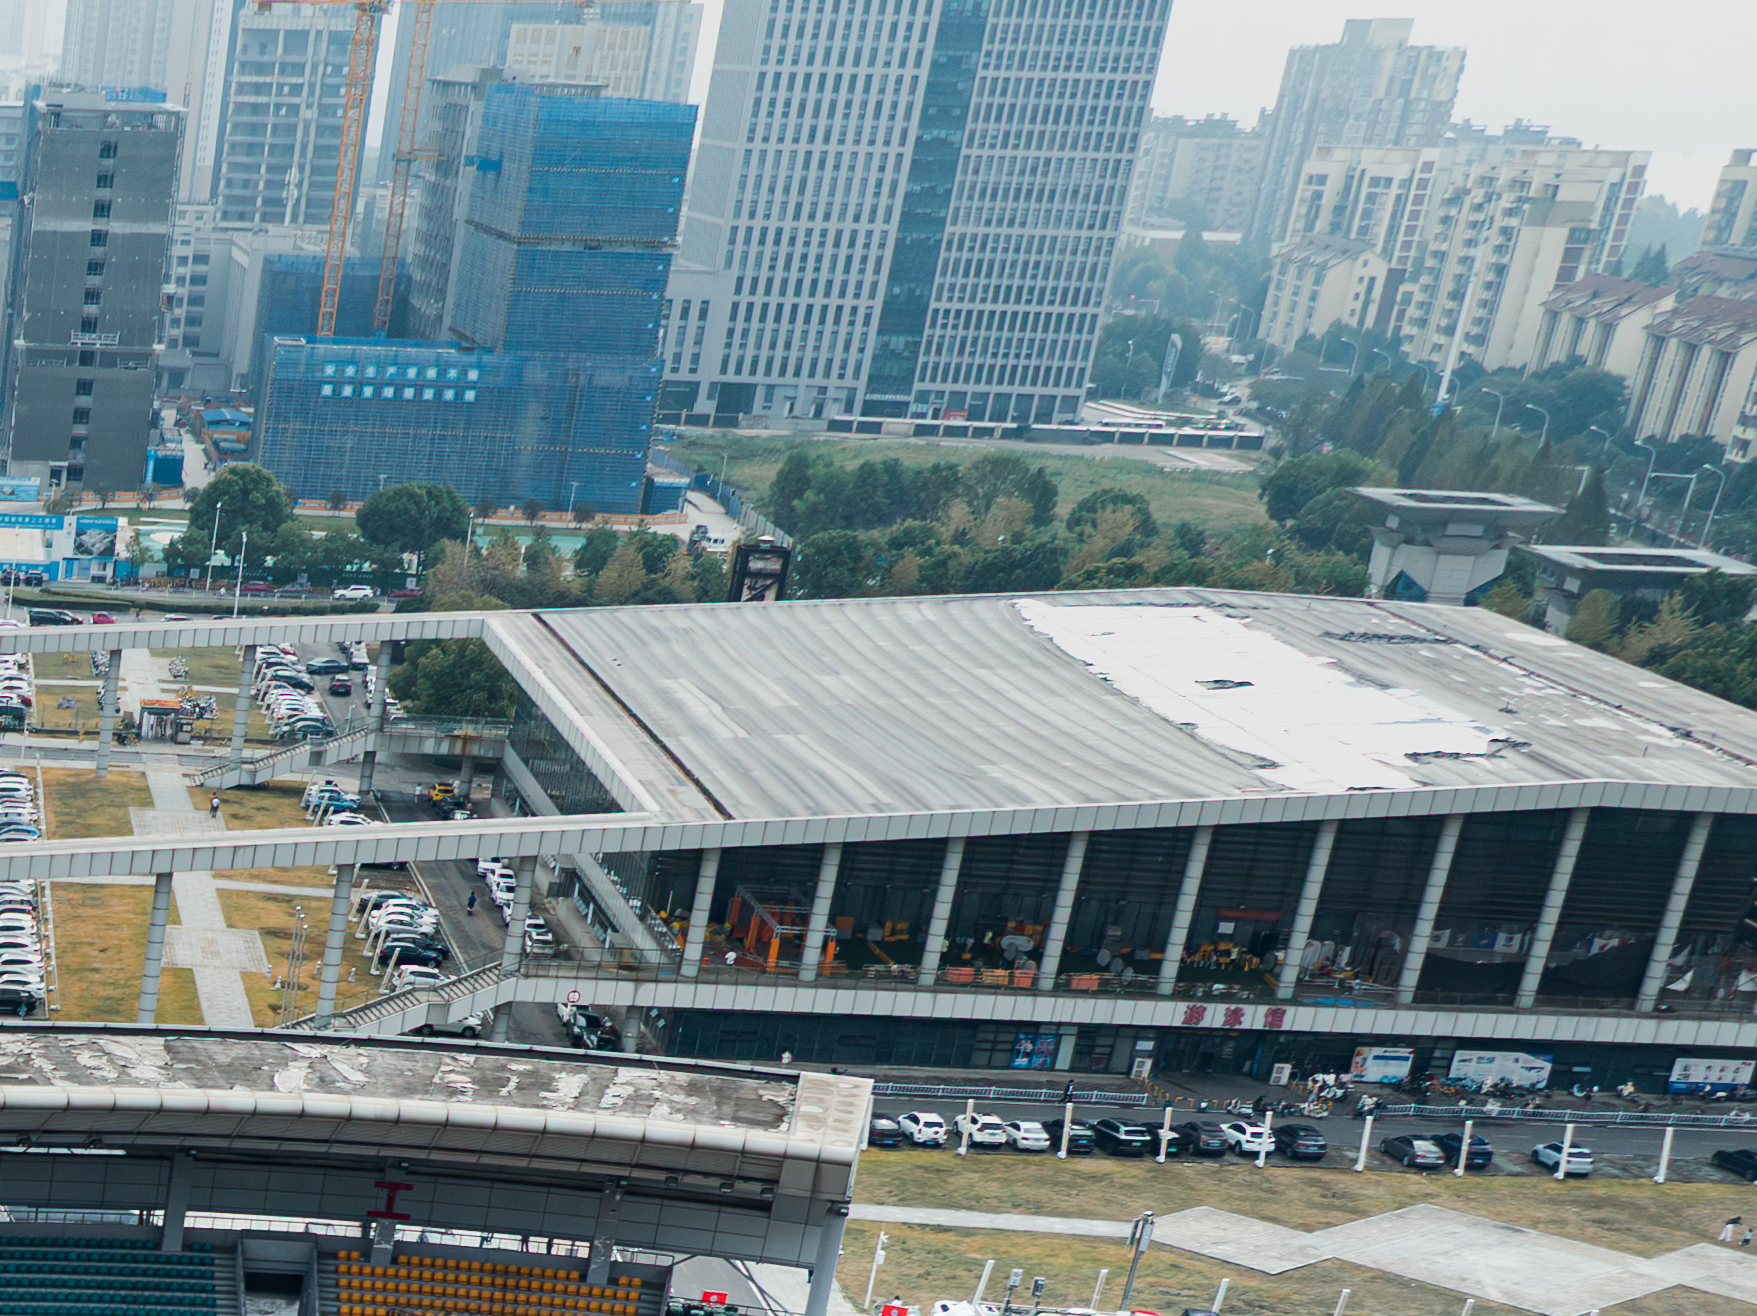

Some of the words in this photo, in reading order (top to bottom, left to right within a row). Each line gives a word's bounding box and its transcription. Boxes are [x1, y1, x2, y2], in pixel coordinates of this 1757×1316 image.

[1182, 1004, 1287, 1029] 游泳馆
[367, 1181, 413, 1221] 工
